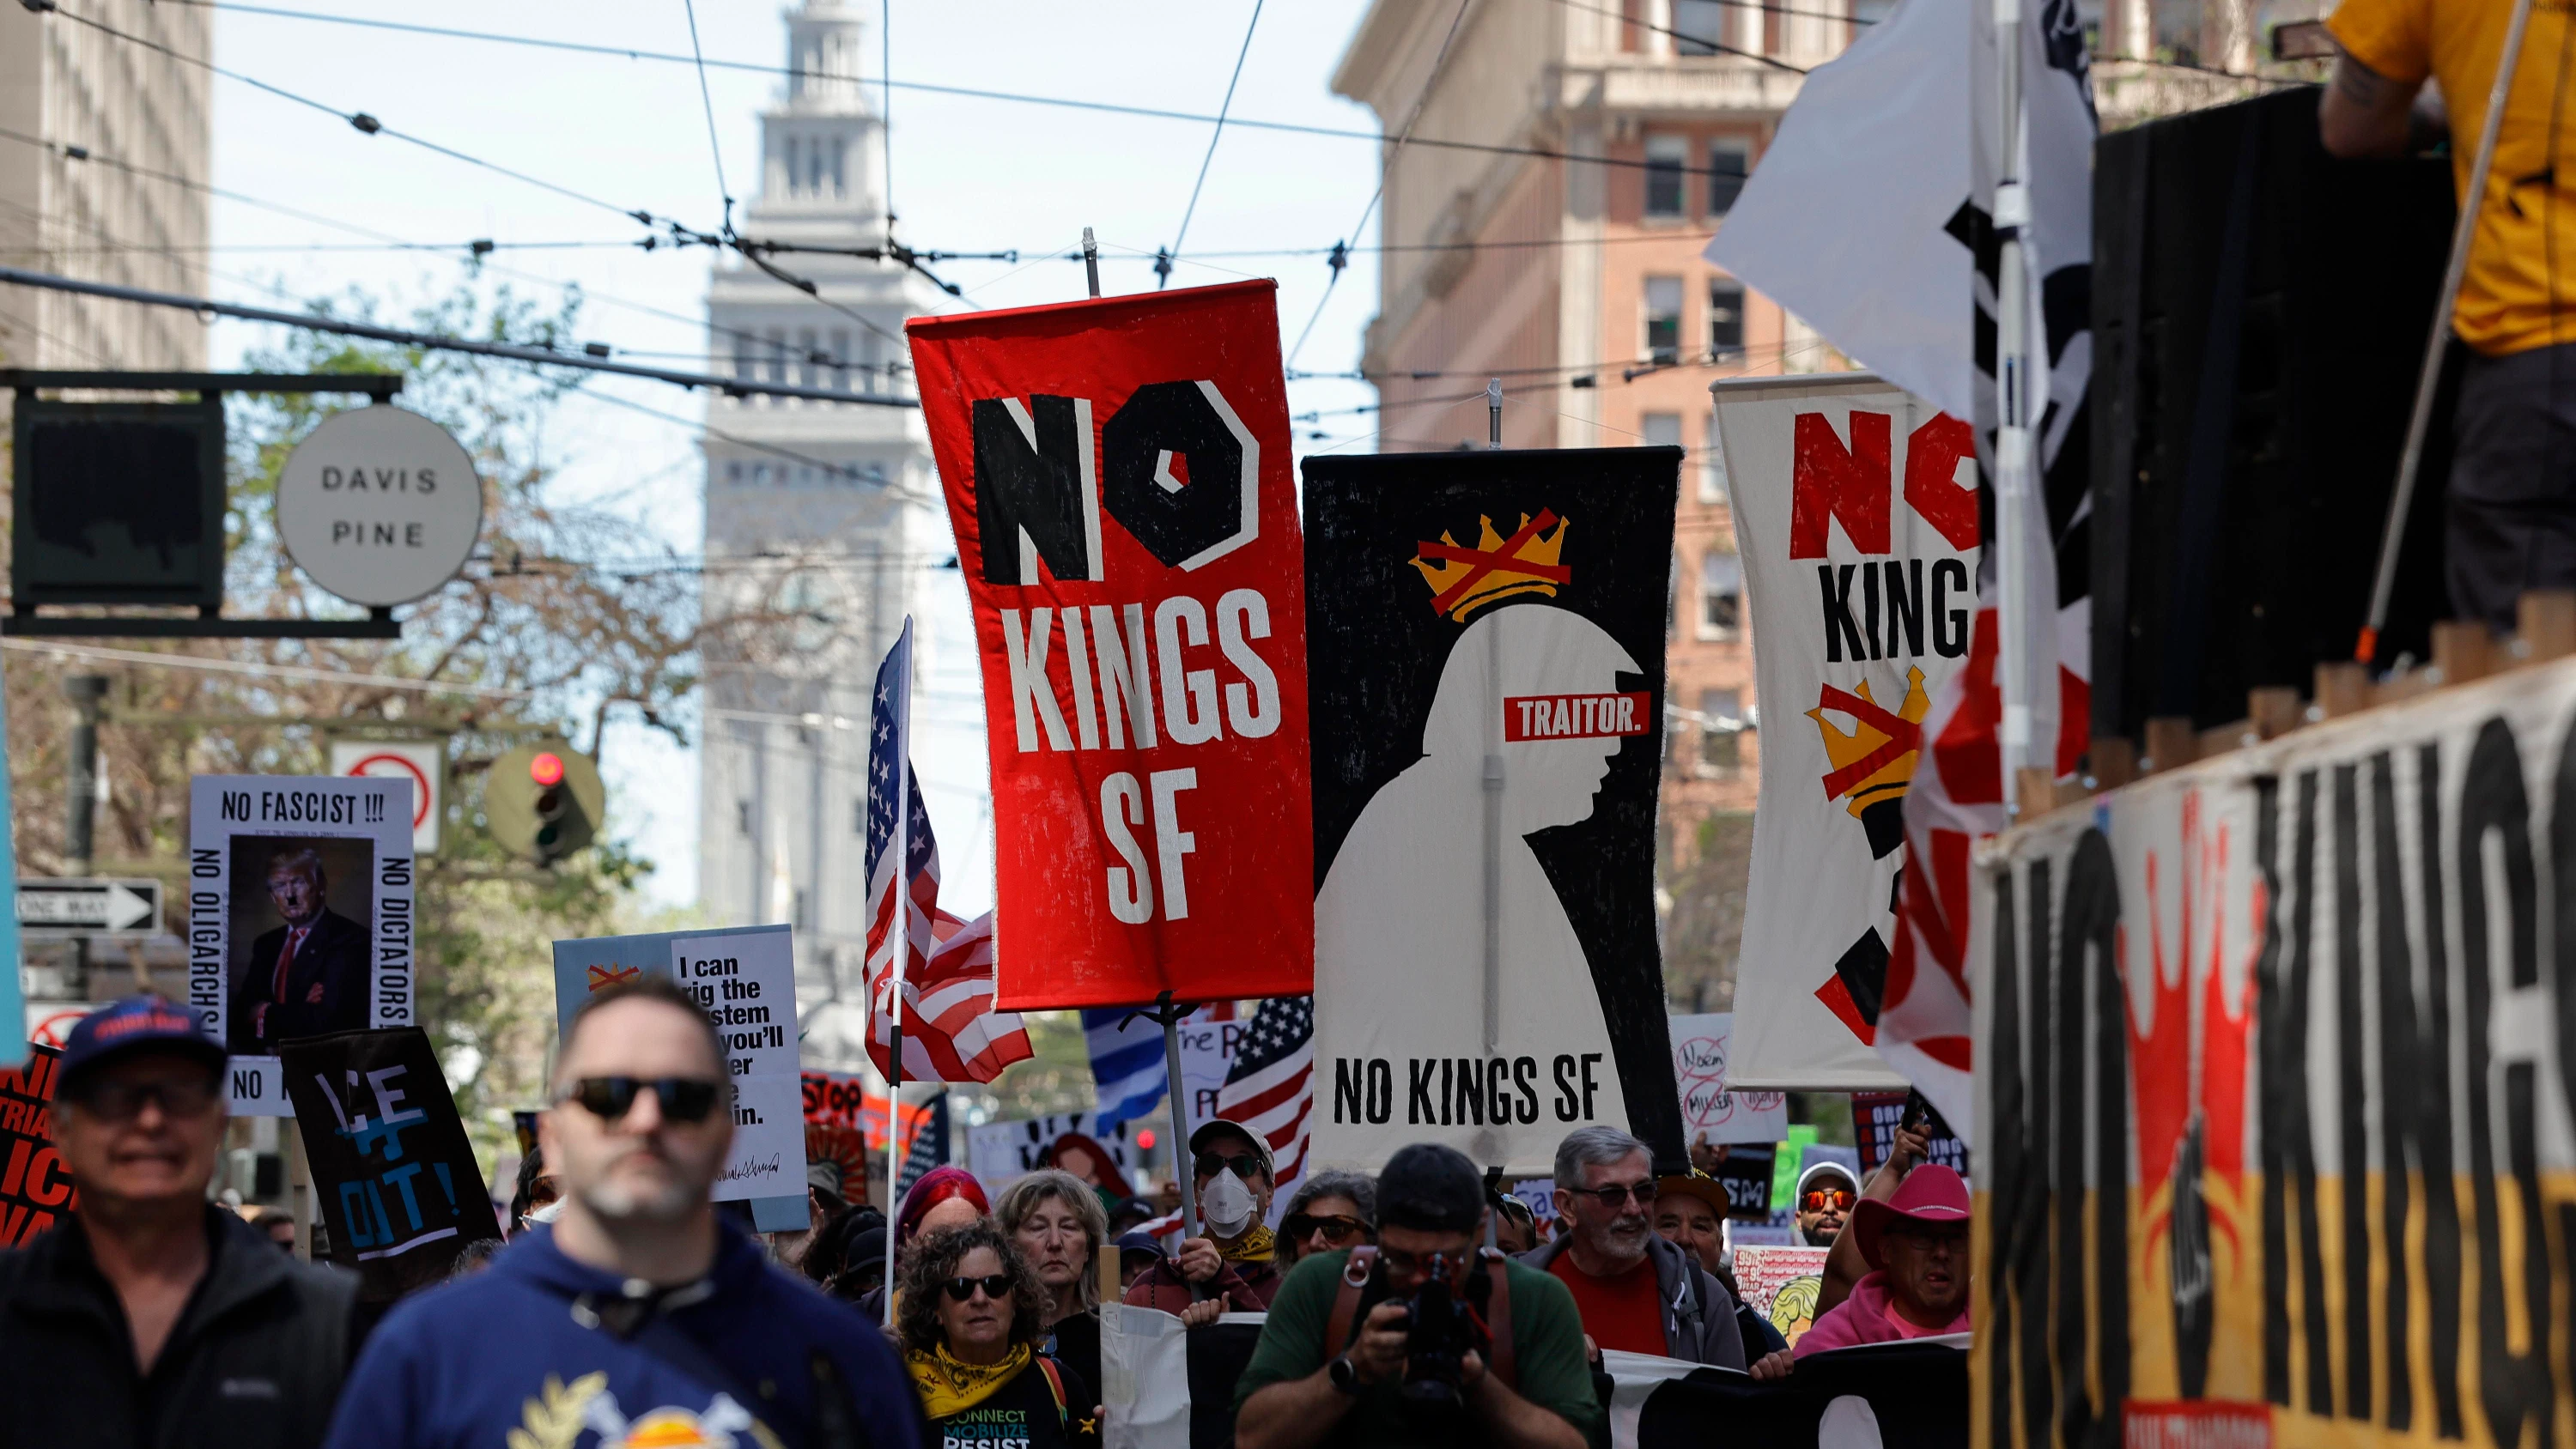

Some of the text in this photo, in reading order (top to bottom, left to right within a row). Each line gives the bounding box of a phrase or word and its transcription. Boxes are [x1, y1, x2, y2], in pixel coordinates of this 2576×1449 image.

[322, 466, 437, 494] DAVIS
[972, 379, 1259, 586] NO
[333, 521, 425, 548] PINE
[1818, 558, 1983, 663] KING
[999, 588, 1281, 753] KINGS
[1517, 697, 1641, 737] TRAITOR.
[222, 791, 251, 822] NO
[261, 791, 356, 824] FASCIST
[1100, 767, 1198, 925] SF
[191, 848, 221, 878] NO
[381, 858, 410, 887] NO
[679, 956, 738, 979] I can
[721, 979, 760, 1000] the
[708, 1004, 770, 1026] stem
[233, 1070, 262, 1100] NO
[1334, 1052, 1602, 1126] NO KINGS SF
[943, 1423, 1030, 1440] MOBILIZE
